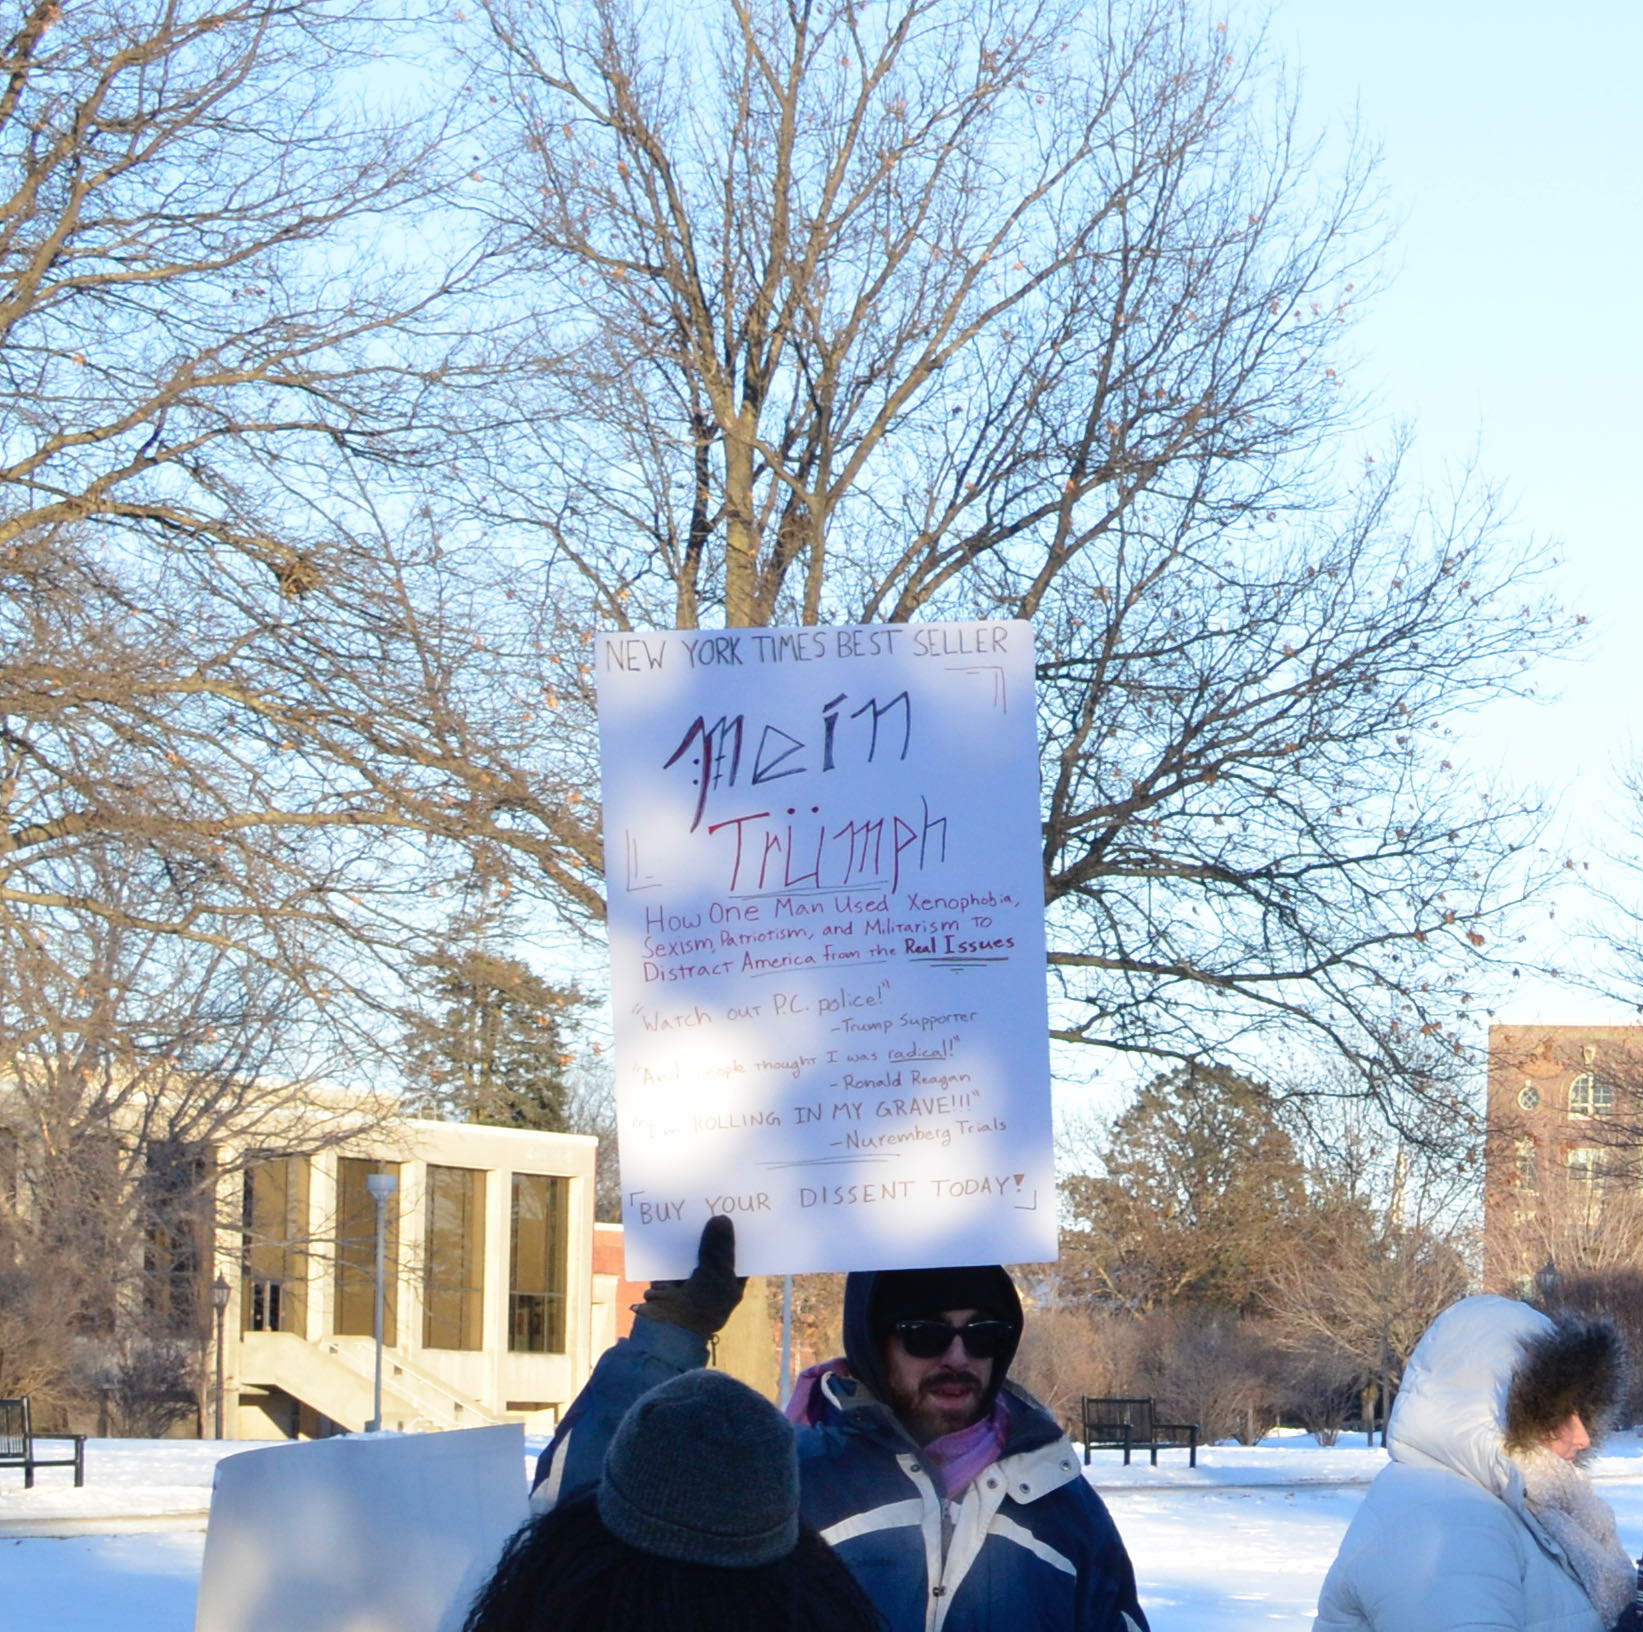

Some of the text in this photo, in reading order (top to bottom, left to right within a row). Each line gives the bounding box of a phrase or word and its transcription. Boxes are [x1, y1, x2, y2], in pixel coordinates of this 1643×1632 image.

[605, 626, 1009, 673] NEW YORK TIMES BEST SELLER
[663, 691, 911, 833] Mein
[645, 892, 1020, 935] How One Man Used Xenophobia,
[642, 936, 716, 960] Sexism,
[720, 929, 815, 949] Patriotism,
[822, 920, 853, 937] and
[864, 919, 960, 936] Militarism
[643, 934, 1015, 983] Distract America from the Real Issues
[727, 1005, 762, 1021] out
[899, 1012, 980, 1032] Supporter
[755, 1053, 818, 1080] thought
[826, 1050, 840, 1064] I
[846, 1051, 879, 1063] was
[911, 1070, 972, 1090] Reagan
[794, 1102, 824, 1125] IN
[831, 1101, 862, 1121] MY
[956, 1117, 1008, 1135] Trials
[640, 1173, 1026, 1226] BUY YOUR DISSENT TODAY!
